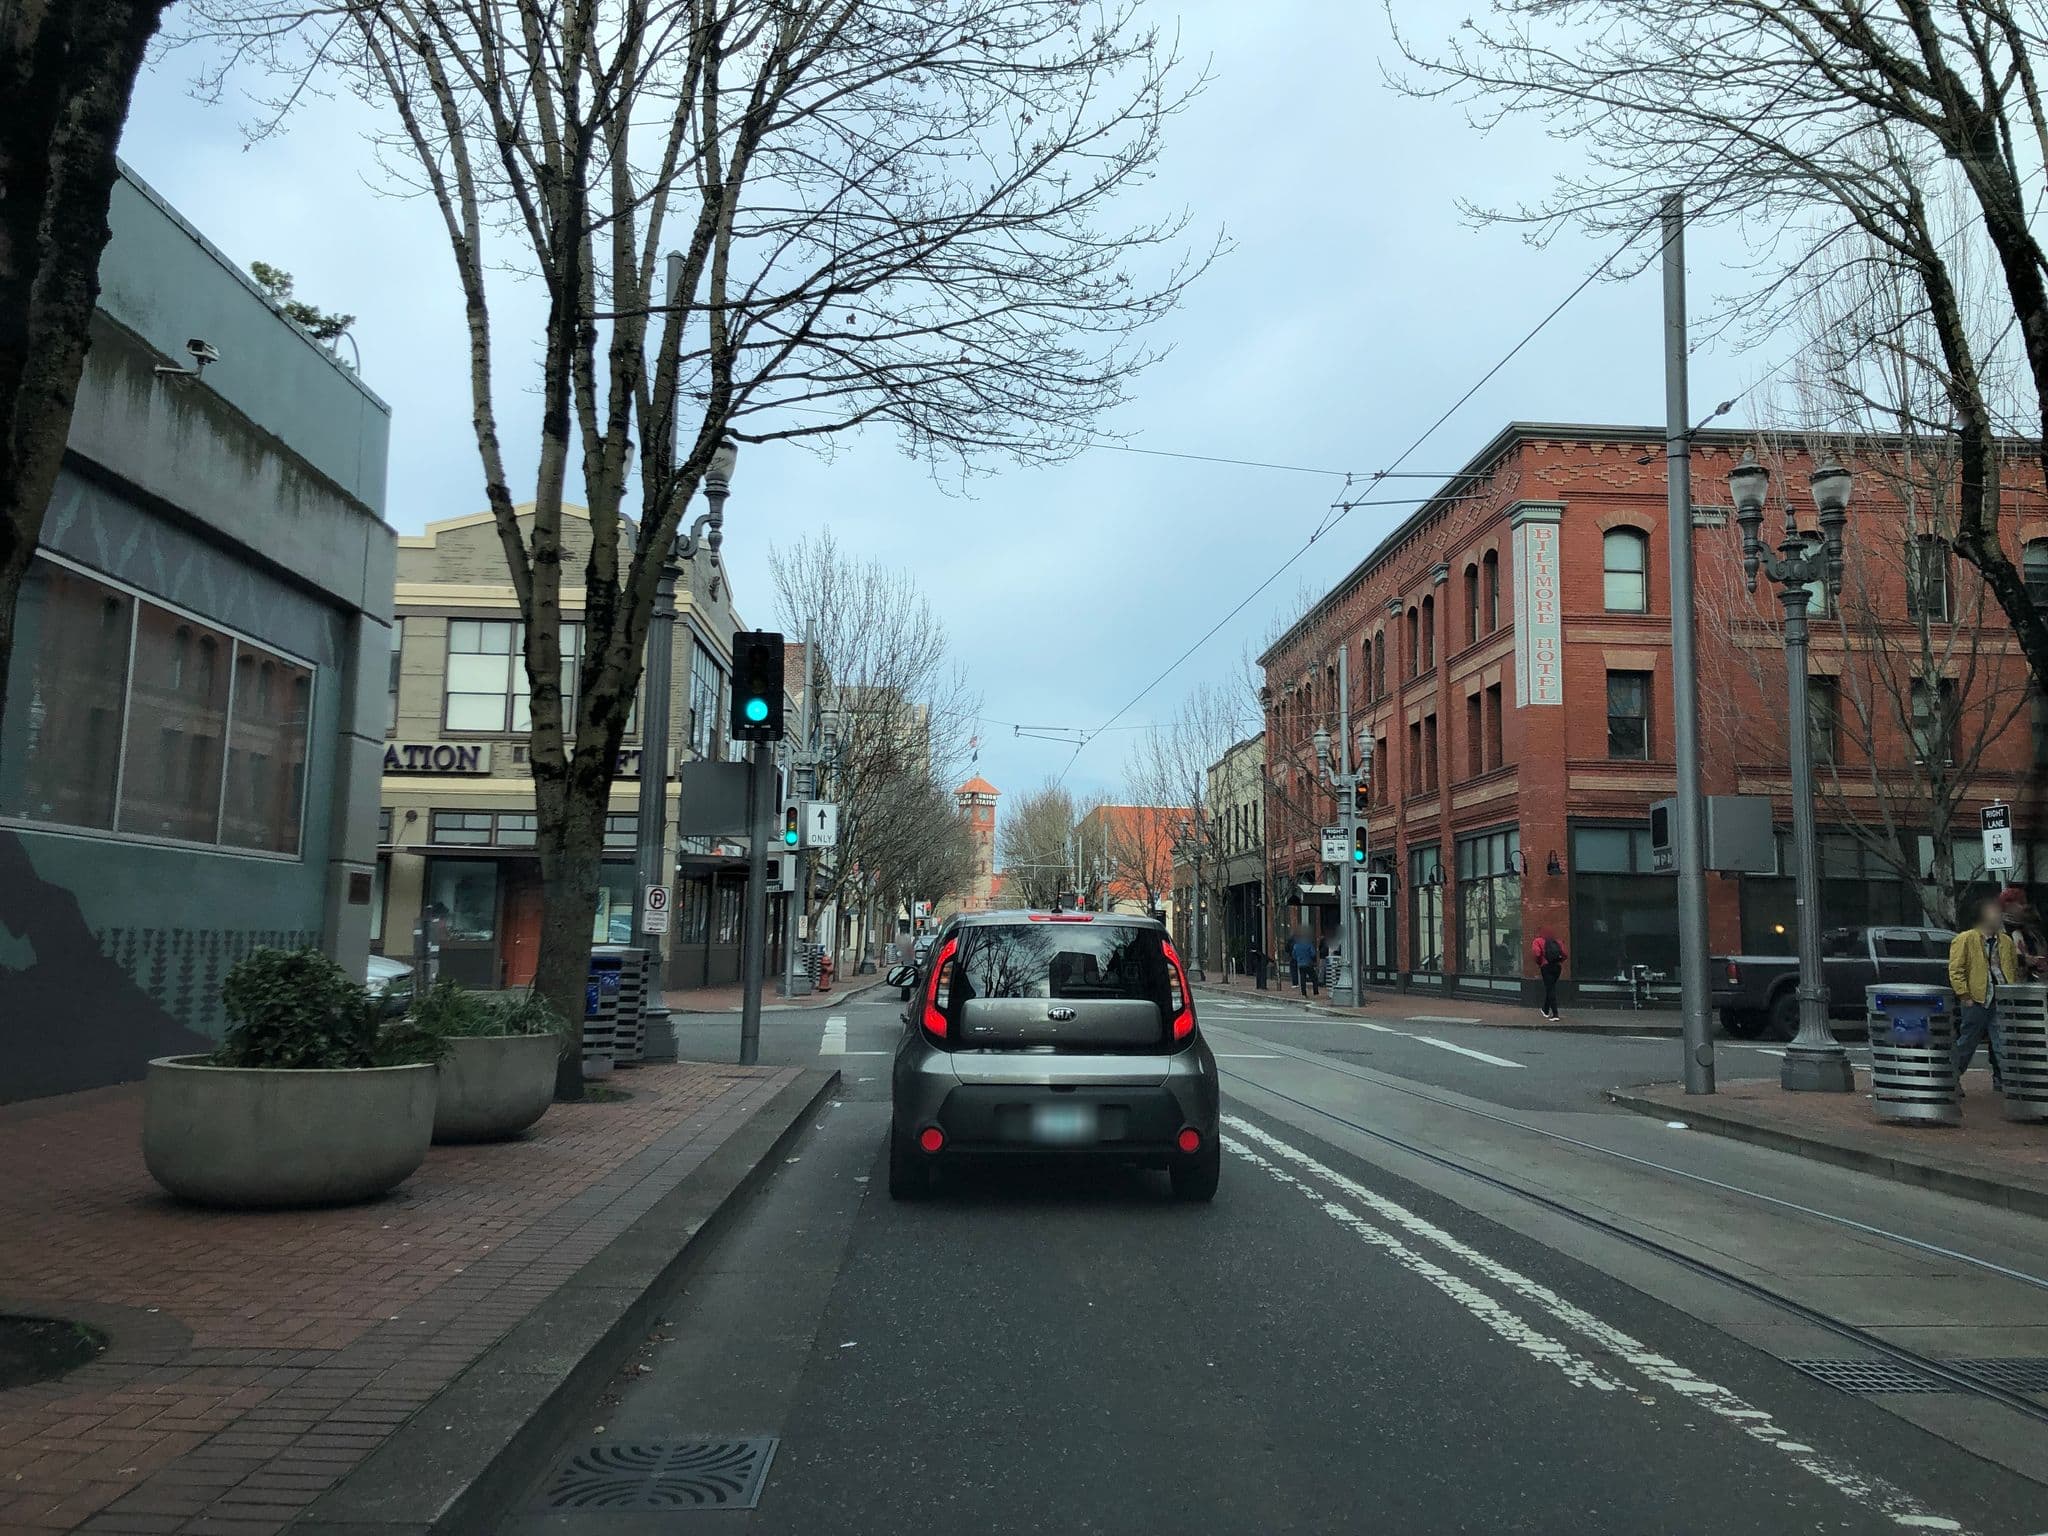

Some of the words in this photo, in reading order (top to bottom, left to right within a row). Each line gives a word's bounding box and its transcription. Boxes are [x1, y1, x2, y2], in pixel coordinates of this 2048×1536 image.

[1534, 528, 1554, 624] BILTMORE
[1537, 638, 1556, 700] HOTEL
[384, 744, 482, 770] ATION
[1986, 808, 2004, 818] RIGHT
[1988, 819, 2005, 828] LANE
[811, 835, 832, 843] ONLY
[1990, 856, 2008, 865] ONLY
